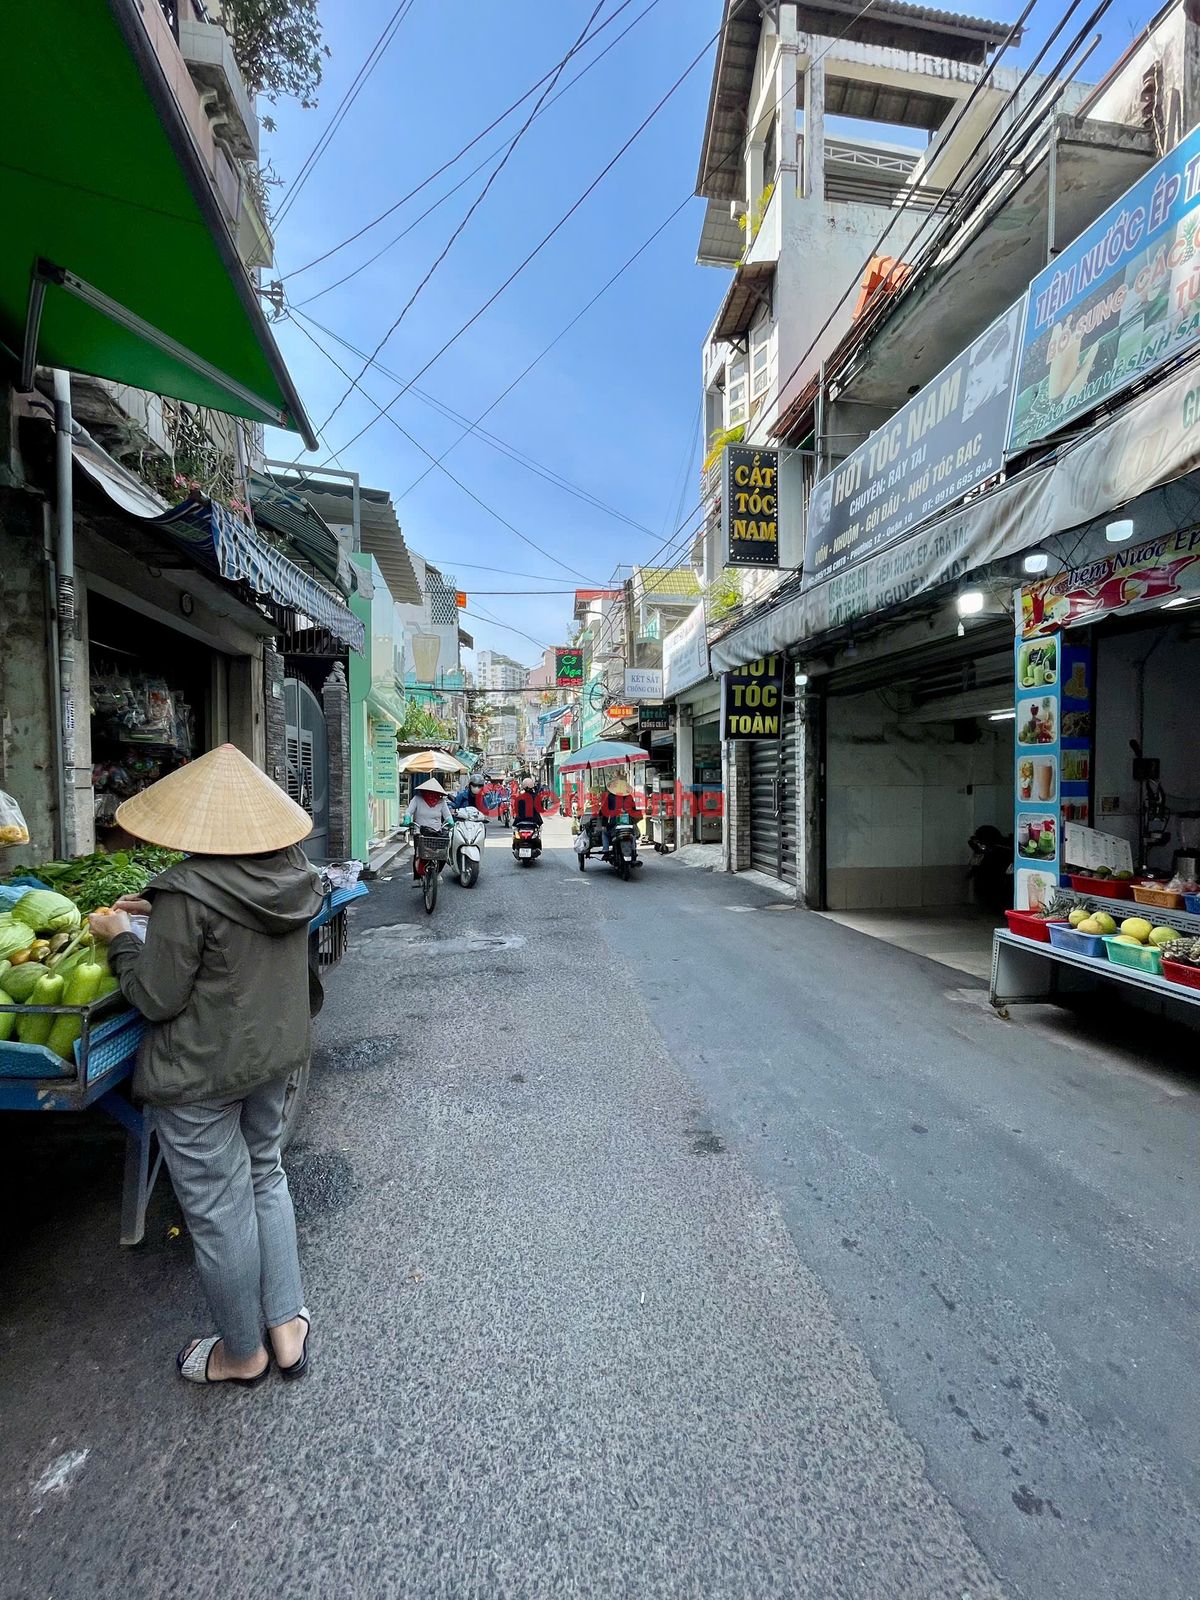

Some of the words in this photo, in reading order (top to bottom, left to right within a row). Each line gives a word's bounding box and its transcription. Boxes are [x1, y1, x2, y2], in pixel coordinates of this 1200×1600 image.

[1034, 270, 1077, 329] TIỆM
[1077, 208, 1146, 294] NƯỚC
[1147, 172, 1181, 235] ÉP
[1076, 283, 1128, 336] SUNG
[1134, 238, 1187, 294] CÁC
[1126, 331, 1172, 373] SINH
[834, 455, 865, 507] HỚT
[868, 422, 902, 480] TÓC
[906, 367, 962, 449] NAM
[734, 454, 775, 489] CẮT
[910, 443, 927, 471] TAI
[734, 487, 775, 516] TÓC
[833, 522, 860, 555] NHUỘM
[865, 507, 881, 532] GỘI
[932, 454, 953, 486] TÓC
[956, 433, 983, 471] BẠC
[732, 519, 776, 542] NAM
[731, 680, 778, 707] TÓC
[728, 711, 778, 734] TOÀN
